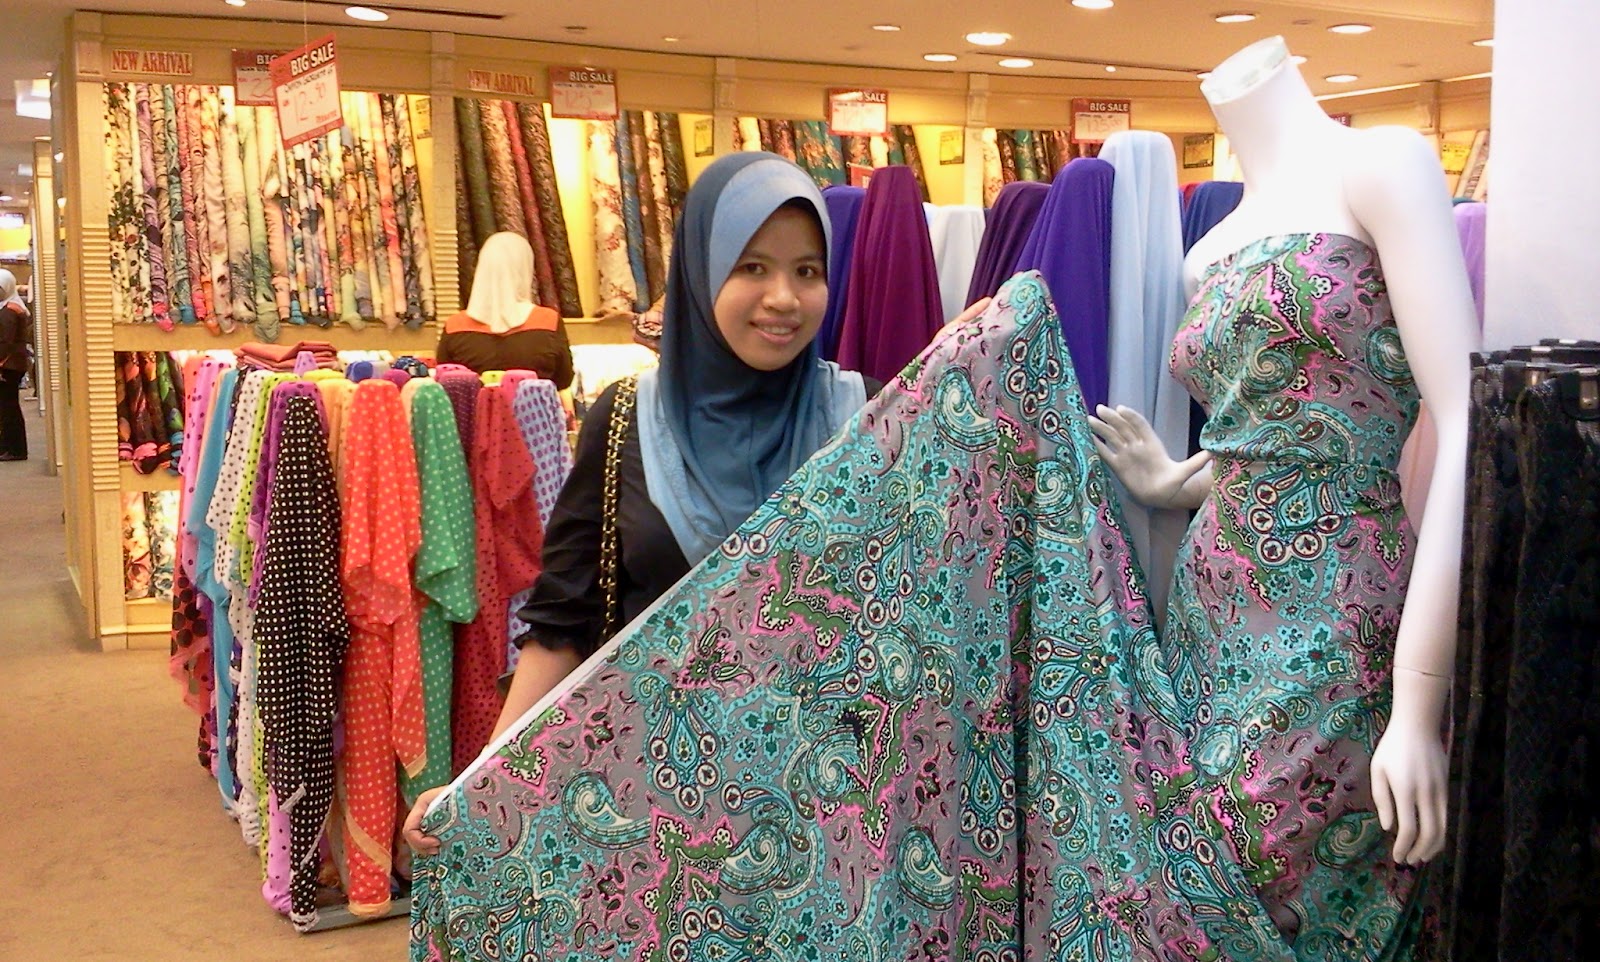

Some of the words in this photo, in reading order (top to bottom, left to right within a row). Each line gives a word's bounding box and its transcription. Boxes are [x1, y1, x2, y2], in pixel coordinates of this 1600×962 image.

[112, 50, 139, 71] NEW
[142, 52, 191, 74] ARRIVAL
[290, 54, 309, 76] BIG
[310, 41, 335, 68] SALE
[569, 70, 588, 82] BIG
[590, 72, 615, 83] SALE
[864, 91, 887, 103] SALE
[1089, 102, 1107, 111] BIG
[1107, 103, 1129, 112] SALE
